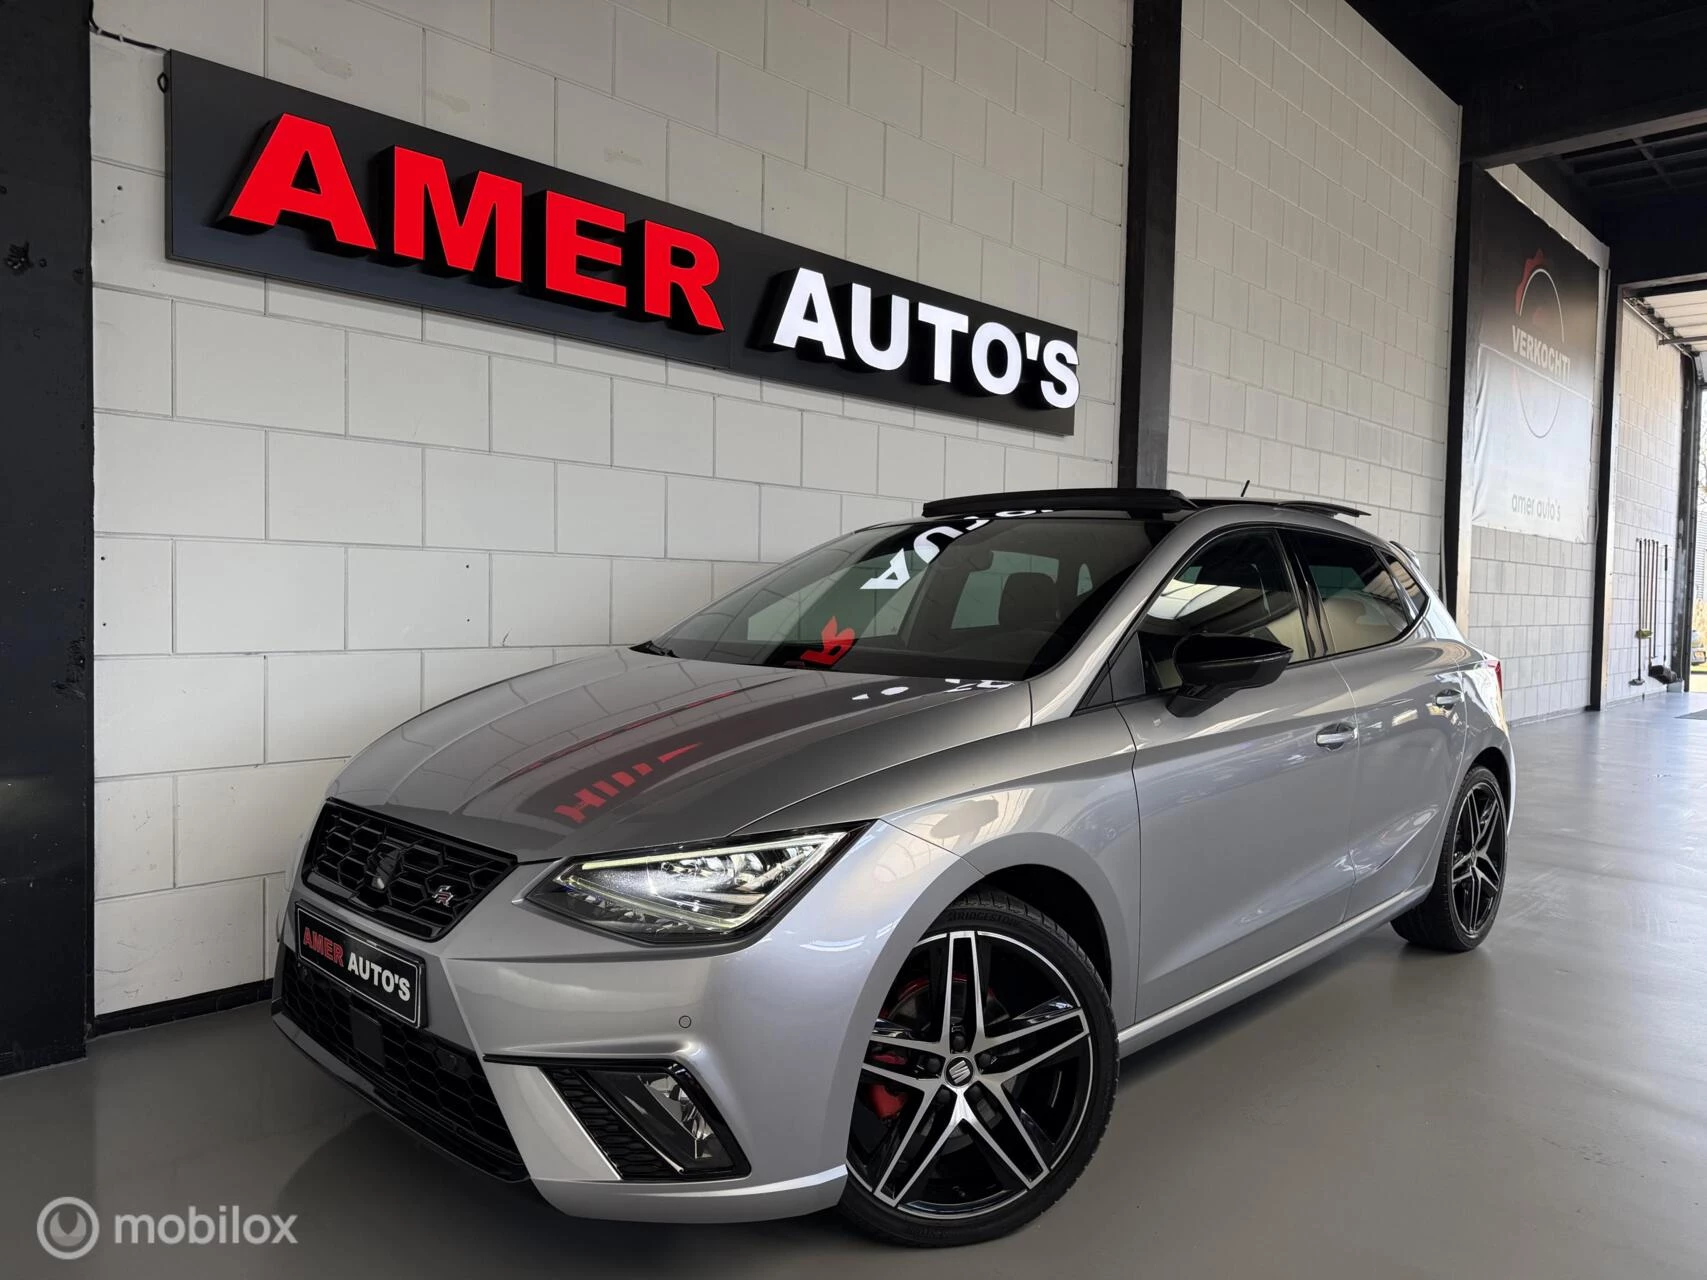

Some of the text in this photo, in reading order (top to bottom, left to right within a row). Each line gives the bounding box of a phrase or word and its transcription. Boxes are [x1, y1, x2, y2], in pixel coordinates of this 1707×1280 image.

[229, 112, 1080, 409] AMER AUTO'S
[1511, 493, 1536, 516] amer
[303, 927, 411, 1002] AMER AUTO'S
